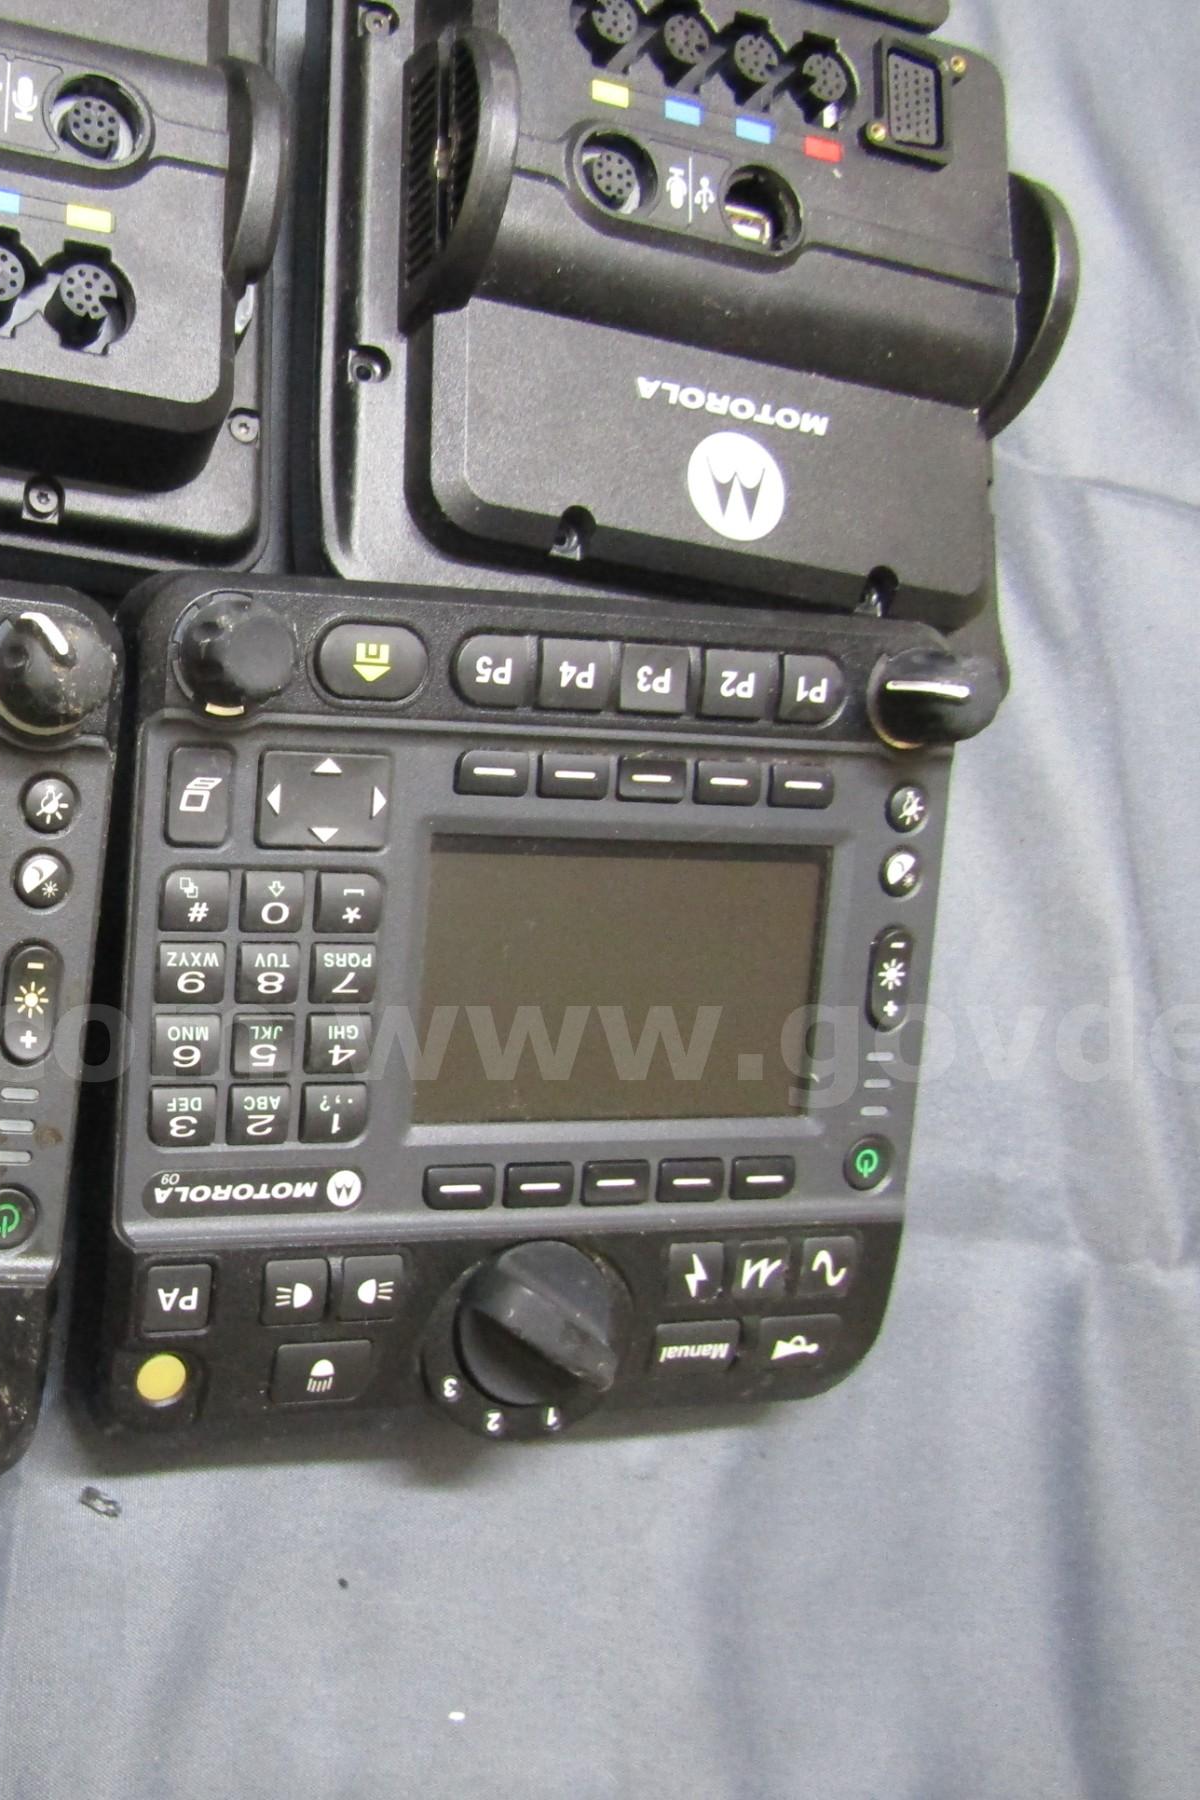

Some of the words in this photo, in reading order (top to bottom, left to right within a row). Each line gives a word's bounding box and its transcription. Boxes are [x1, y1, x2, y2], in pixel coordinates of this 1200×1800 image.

[635, 376, 830, 437] MOTOROLA
[475, 655, 513, 685] P5
[558, 660, 596, 689] P4
[636, 665, 672, 694] P3
[720, 670, 756, 699] P2
[796, 675, 829, 704] P1
[166, 951, 219, 967] WXYZ
[254, 952, 290, 968] TUV
[323, 952, 372, 968] PQRS
[176, 970, 206, 994] 9
[256, 971, 286, 994] 8
[331, 971, 359, 994] 7
[167, 1025, 209, 1042] MNO
[249, 1025, 283, 1041] JKL
[328, 1024, 359, 1040] GHI
[172, 1045, 201, 1068] 6
[249, 1043, 278, 1067] 5
[328, 1044, 357, 1066] 4
[167, 1096, 202, 1112] DEF
[243, 1095, 281, 1111] ABC
[169, 1115, 198, 1138] 3
[246, 1114, 276, 1136] 2
[331, 1112, 341, 1134] 1
[153, 1181, 318, 1206] MOTOROLA
[157, 1286, 199, 1312] PA
[659, 1342, 730, 1363] Manual
[443, 1377, 458, 1398] 3
[486, 1412, 501, 1432] 2
[546, 1407, 558, 1426] 1
